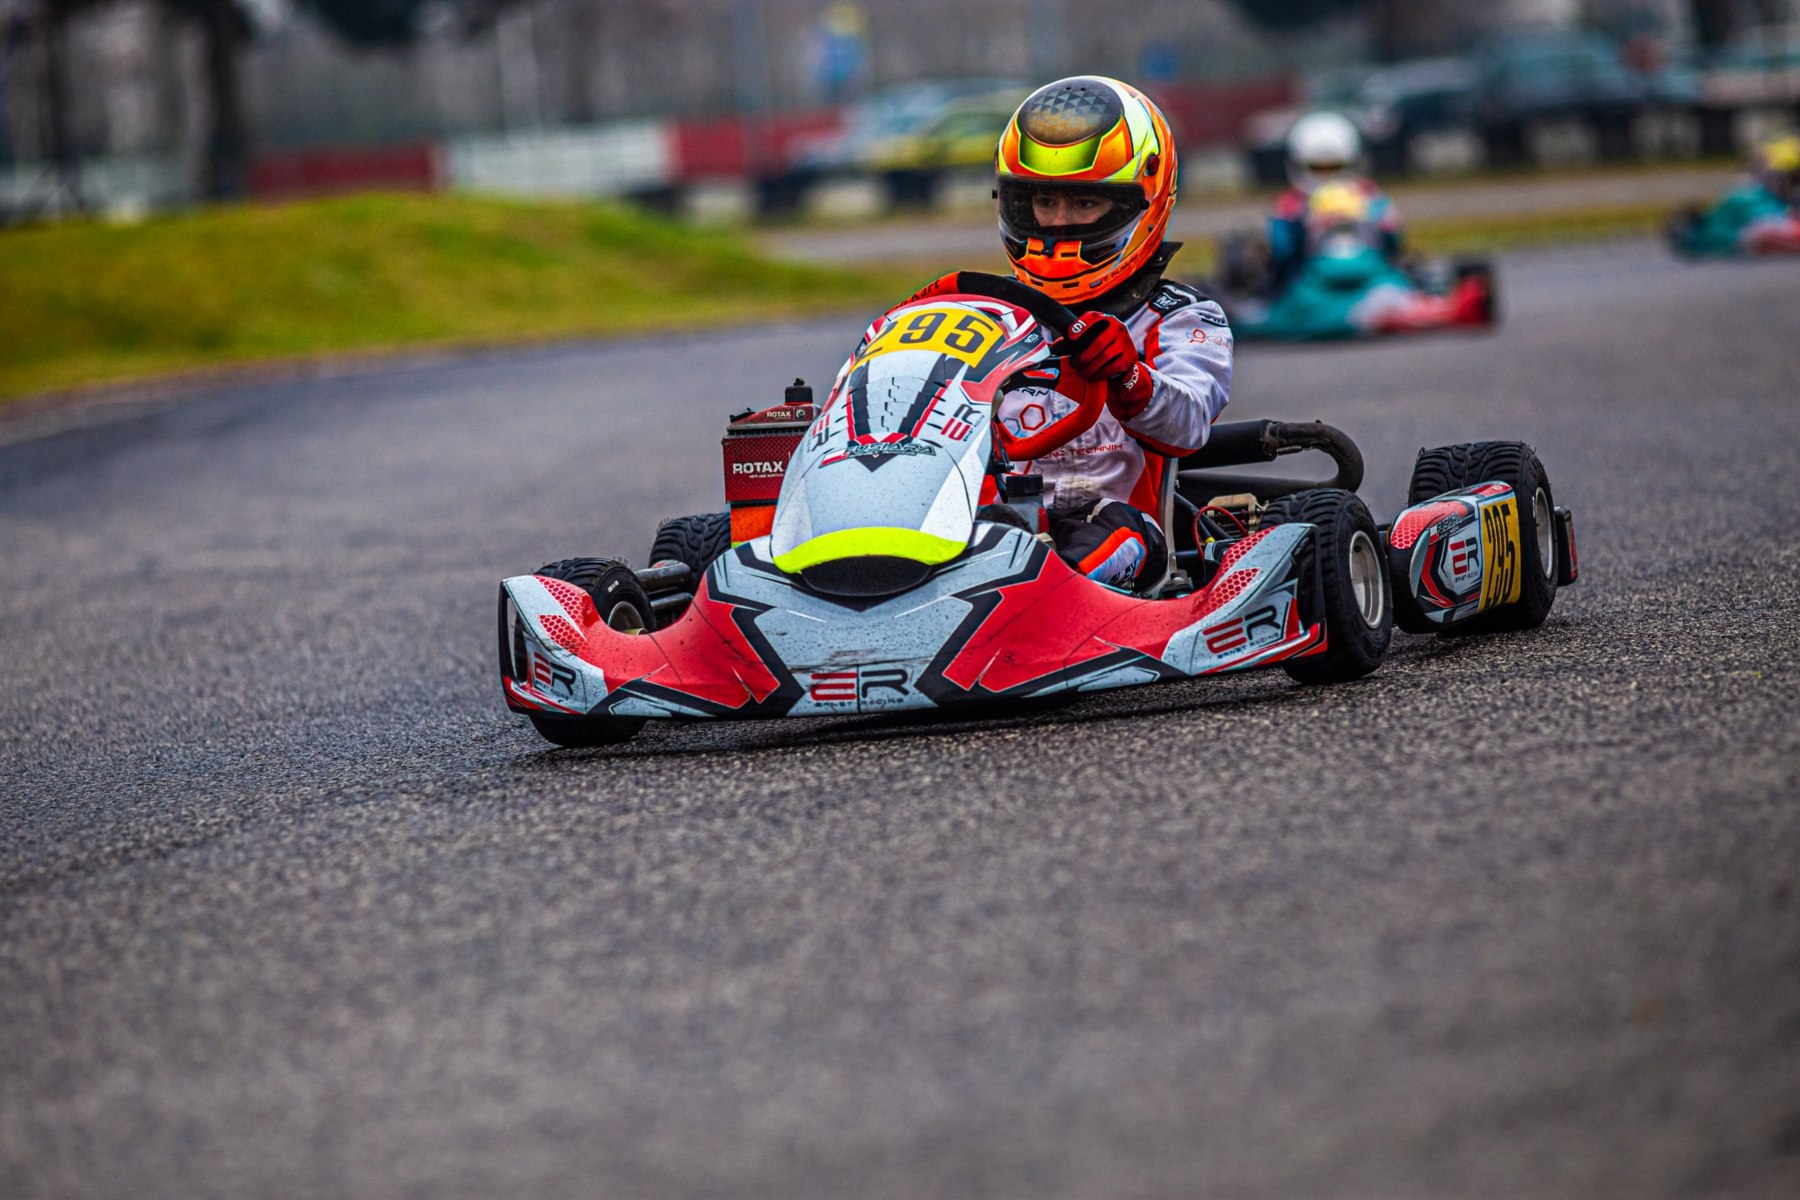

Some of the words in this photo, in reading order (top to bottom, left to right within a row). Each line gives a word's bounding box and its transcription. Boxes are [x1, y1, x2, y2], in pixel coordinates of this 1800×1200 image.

[856, 312, 994, 360] 295
[732, 461, 784, 474] ROTAX
[1450, 536, 1480, 575] ER
[1484, 502, 1516, 609] 295
[1202, 604, 1281, 654] ER
[534, 651, 577, 696] ER
[810, 668, 910, 701] ER
